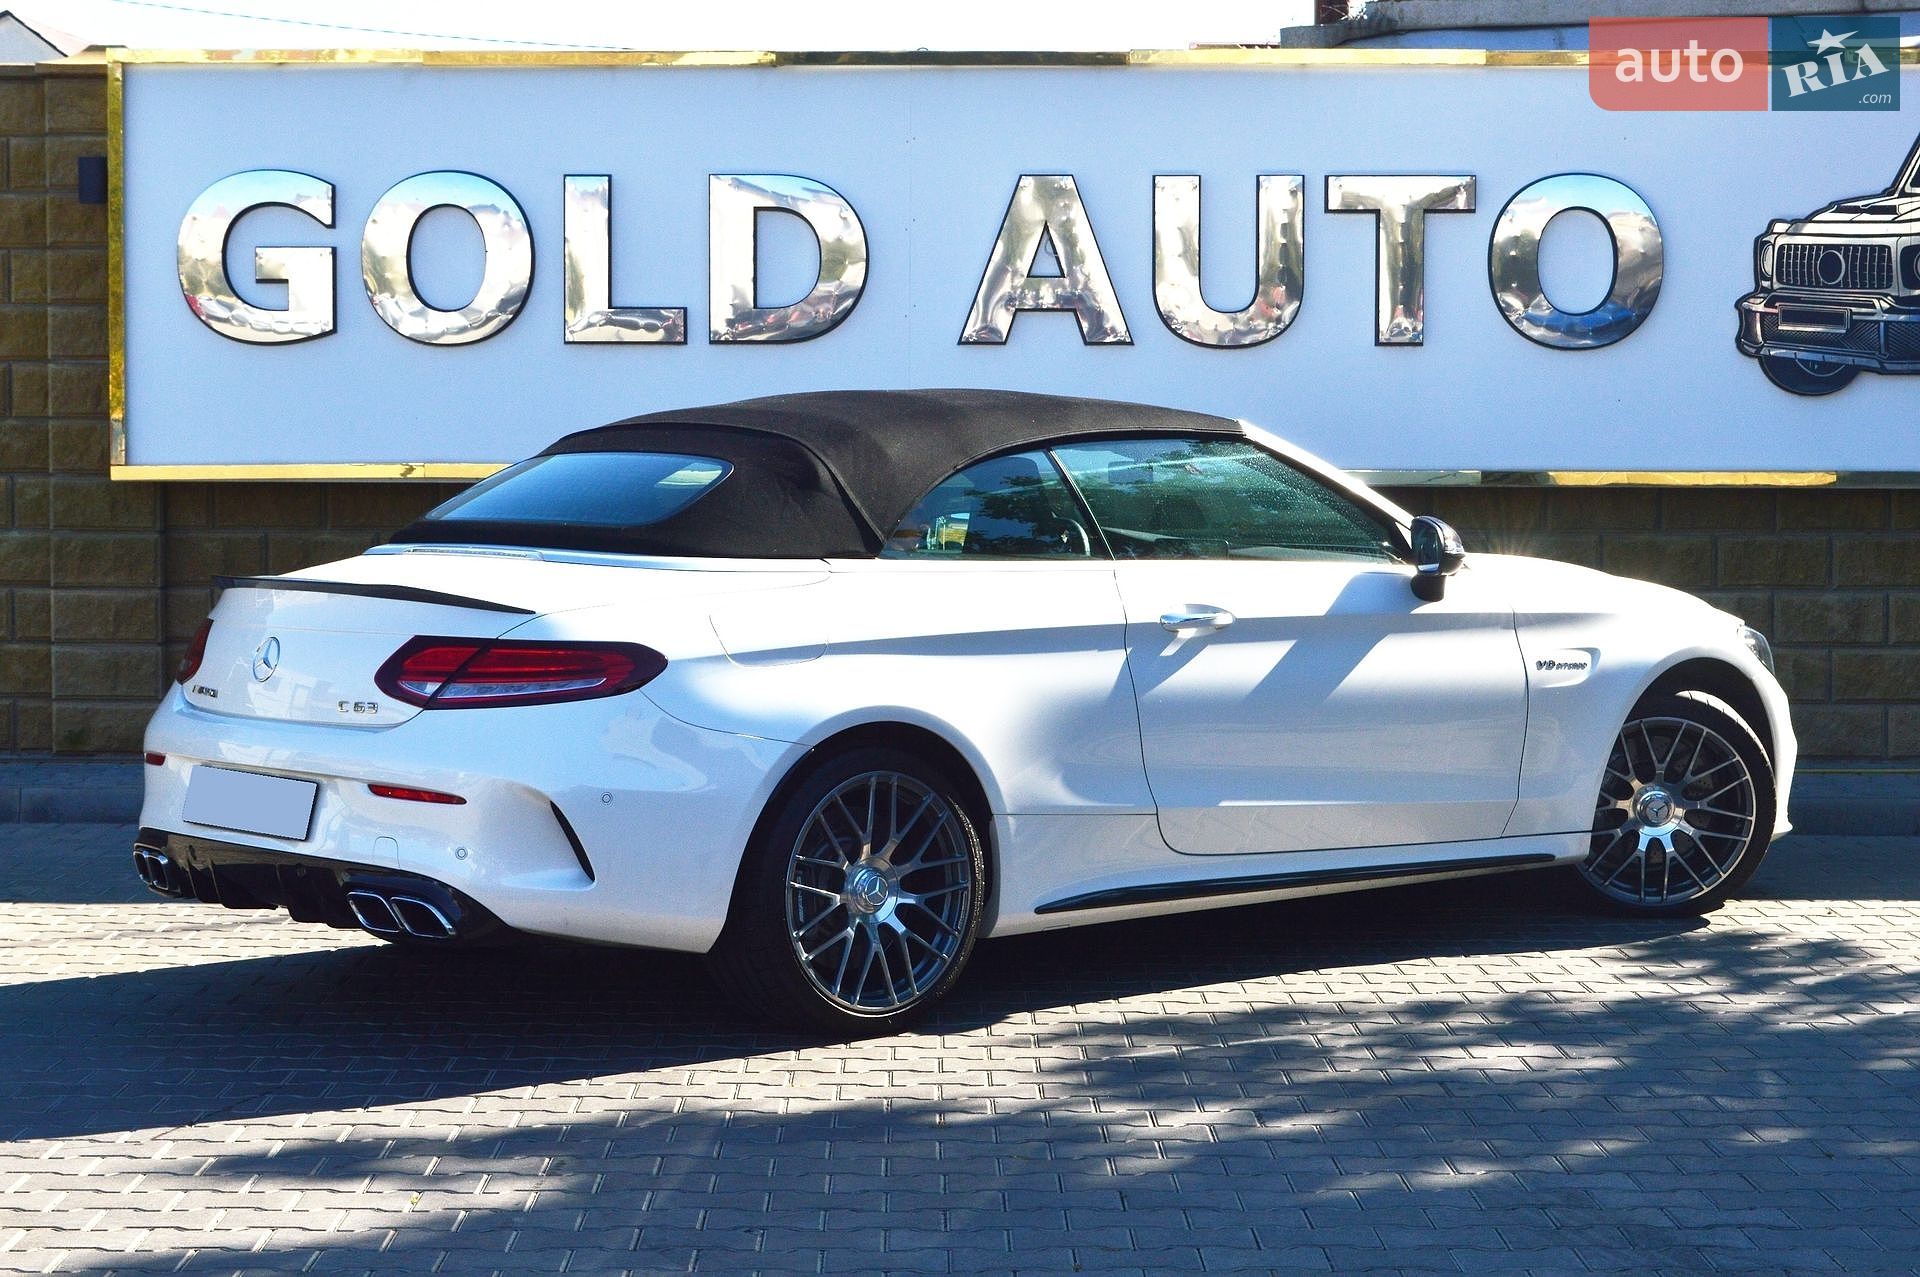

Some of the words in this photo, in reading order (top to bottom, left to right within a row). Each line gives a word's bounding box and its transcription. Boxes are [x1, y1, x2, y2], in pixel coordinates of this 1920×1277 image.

[176, 168, 869, 346] GOLD
[957, 173, 1664, 350] AUTO
[353, 701, 379, 714] 63
